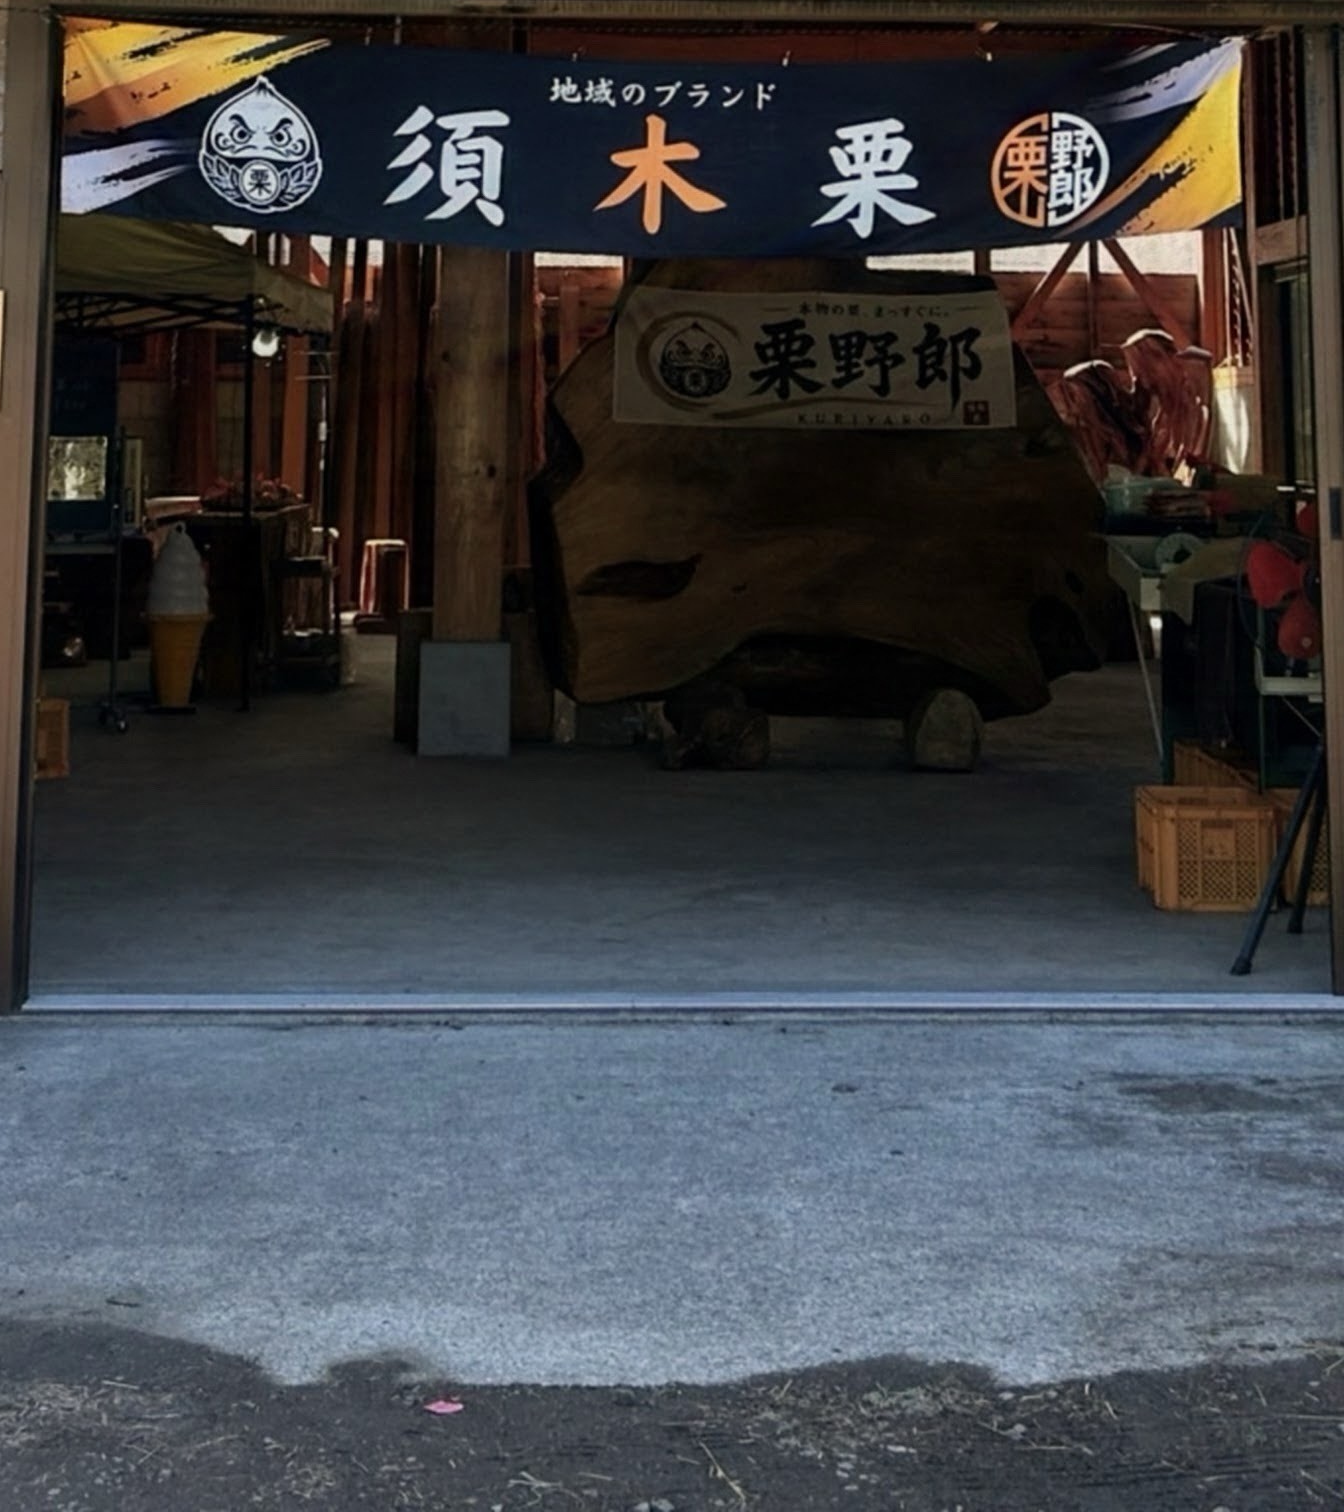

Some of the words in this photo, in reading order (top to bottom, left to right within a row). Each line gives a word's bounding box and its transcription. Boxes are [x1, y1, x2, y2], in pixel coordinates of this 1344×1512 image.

[550, 76, 776, 110] 地域のブランド
[748, 318, 982, 407] 栗野郎
